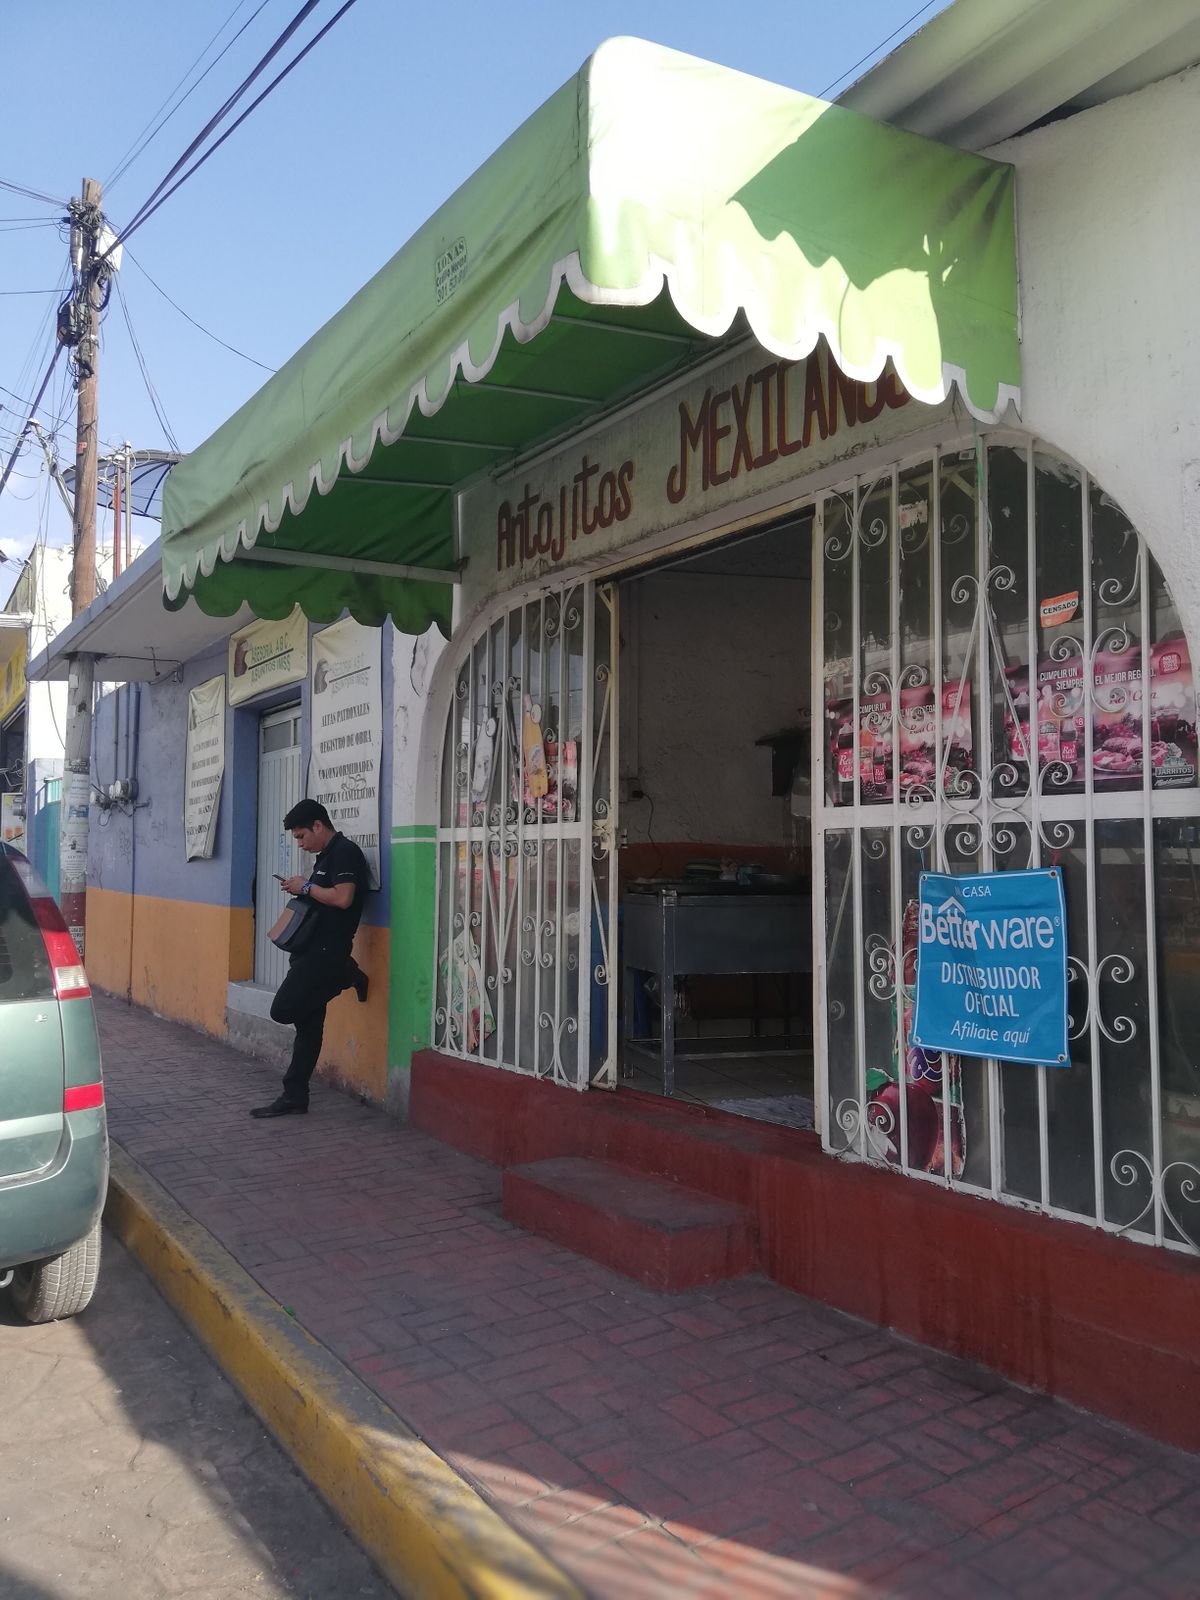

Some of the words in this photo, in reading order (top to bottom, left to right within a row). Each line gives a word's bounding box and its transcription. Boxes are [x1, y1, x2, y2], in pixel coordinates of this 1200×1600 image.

[1042, 600, 1077, 615] CENSADO
[276, 654, 291, 672] IMSS
[1039, 669, 1067, 682] CUMPLIR
[1067, 667, 1078, 677] UN
[1095, 675, 1104, 685] EL
[1104, 672, 1126, 684] MEJOR
[320, 736, 345, 754] REGISTRO
[346, 733, 354, 747] DE
[355, 730, 372, 744] OBRA
[1157, 766, 1192, 776] JARRITOS
[962, 886, 992, 898] CASA
[941, 961, 1041, 990] DISTRIBUIDOR
[964, 991, 1019, 1017] OFICIAL
[1002, 1027, 1030, 1048] aquí
